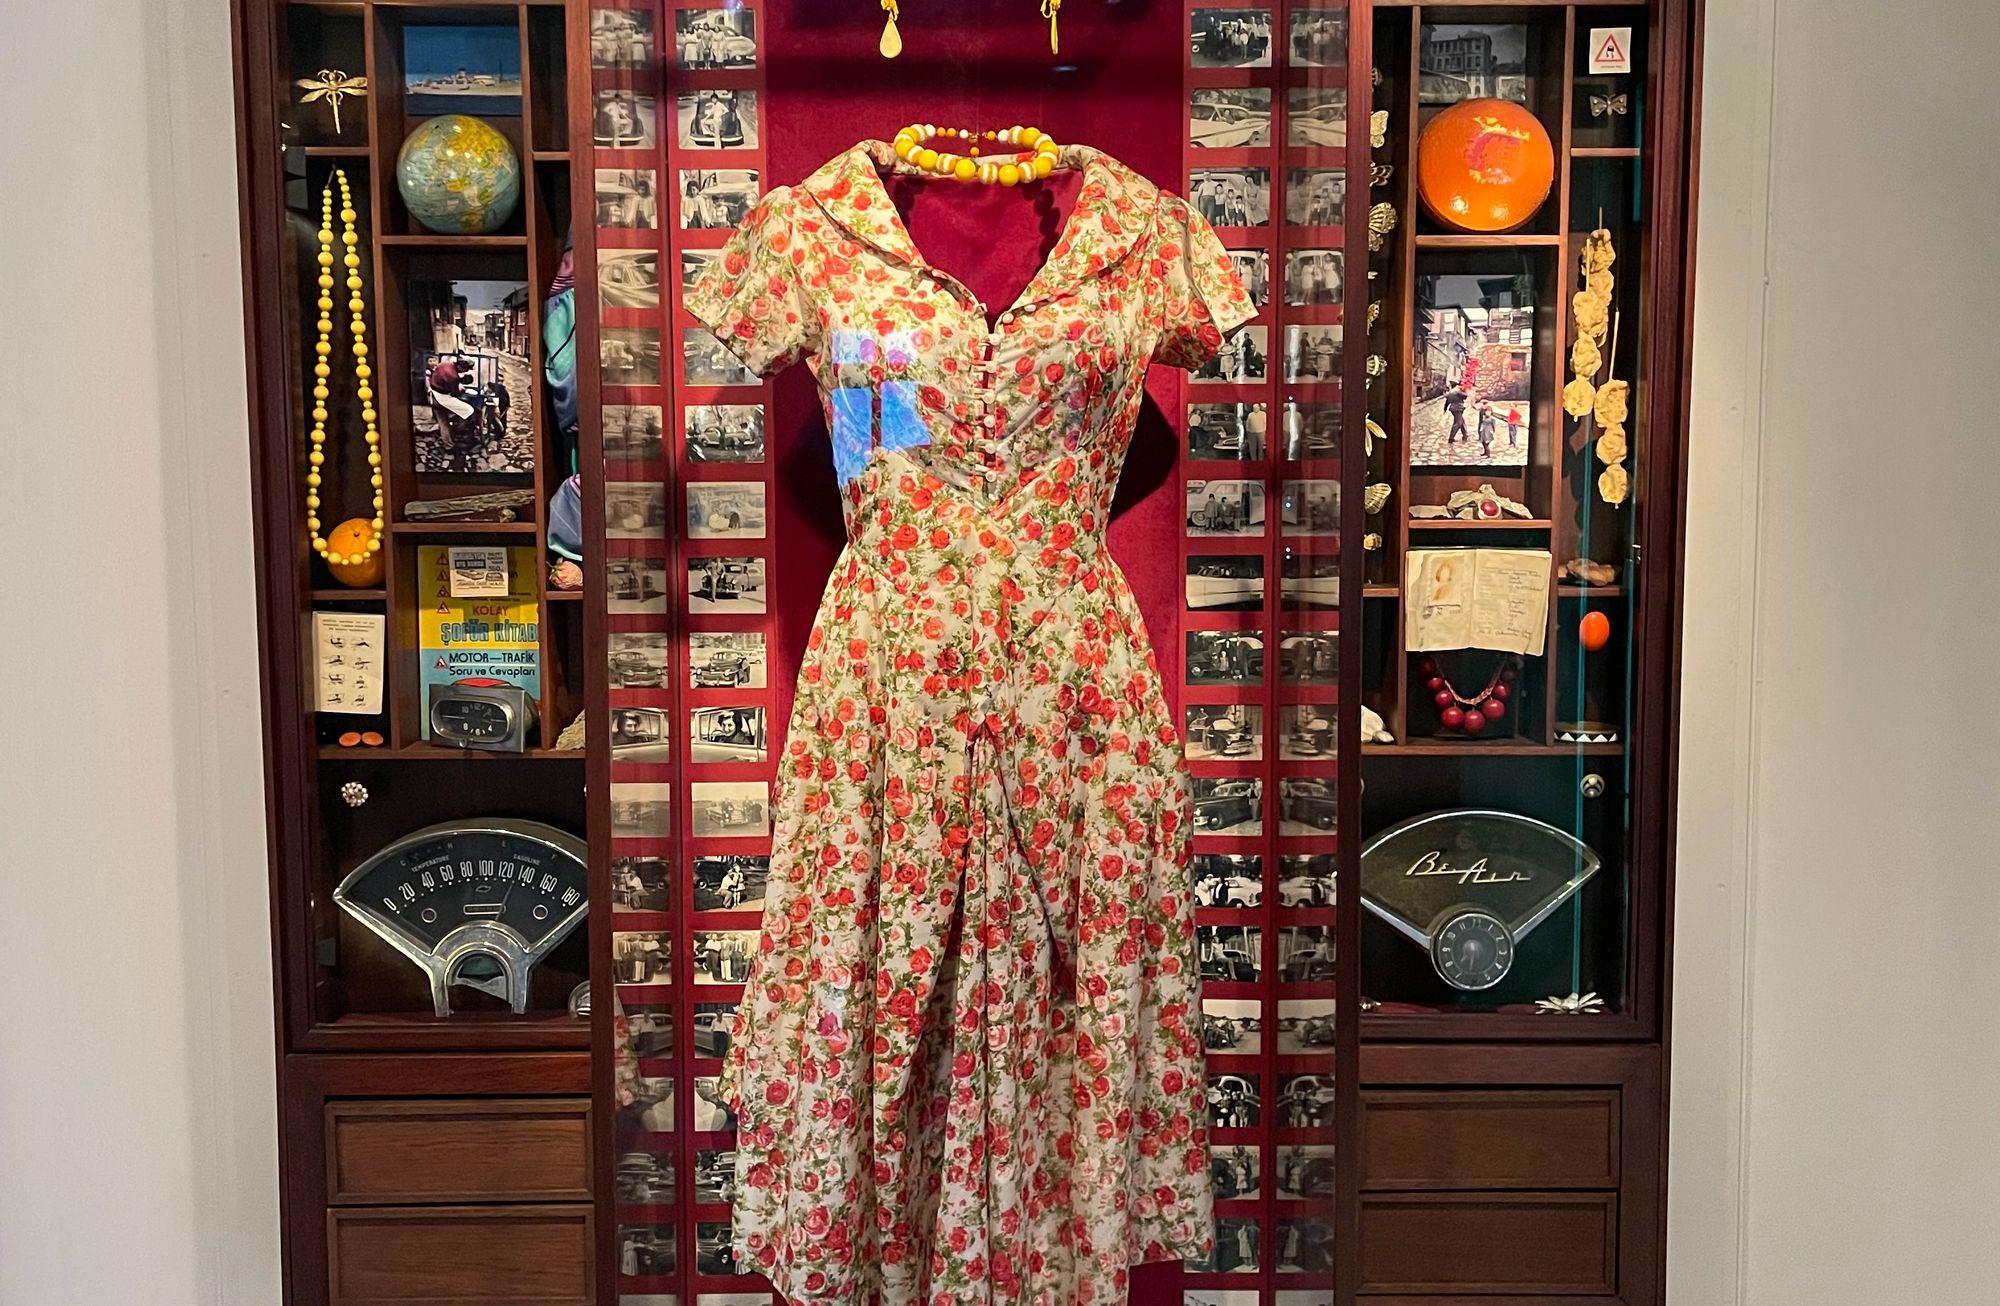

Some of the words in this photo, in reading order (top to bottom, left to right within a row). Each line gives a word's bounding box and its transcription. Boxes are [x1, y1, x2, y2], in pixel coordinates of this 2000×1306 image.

[472, 605, 509, 616] KOLAY
[494, 618, 538, 642] KİTAB
[449, 665, 472, 676] Soru
[475, 668, 487, 676] ve
[489, 665, 535, 678] Cevapları
[383, 897, 397, 911] 0
[398, 882, 416, 900] 20
[421, 871, 435, 888] 40
[440, 864, 454, 882] 60
[460, 860, 473, 878] 80
[478, 859, 494, 877] 100
[498, 860, 514, 878] 120
[517, 864, 535, 884] 140
[539, 872, 558, 893] 160
[561, 886, 580, 906] 180
